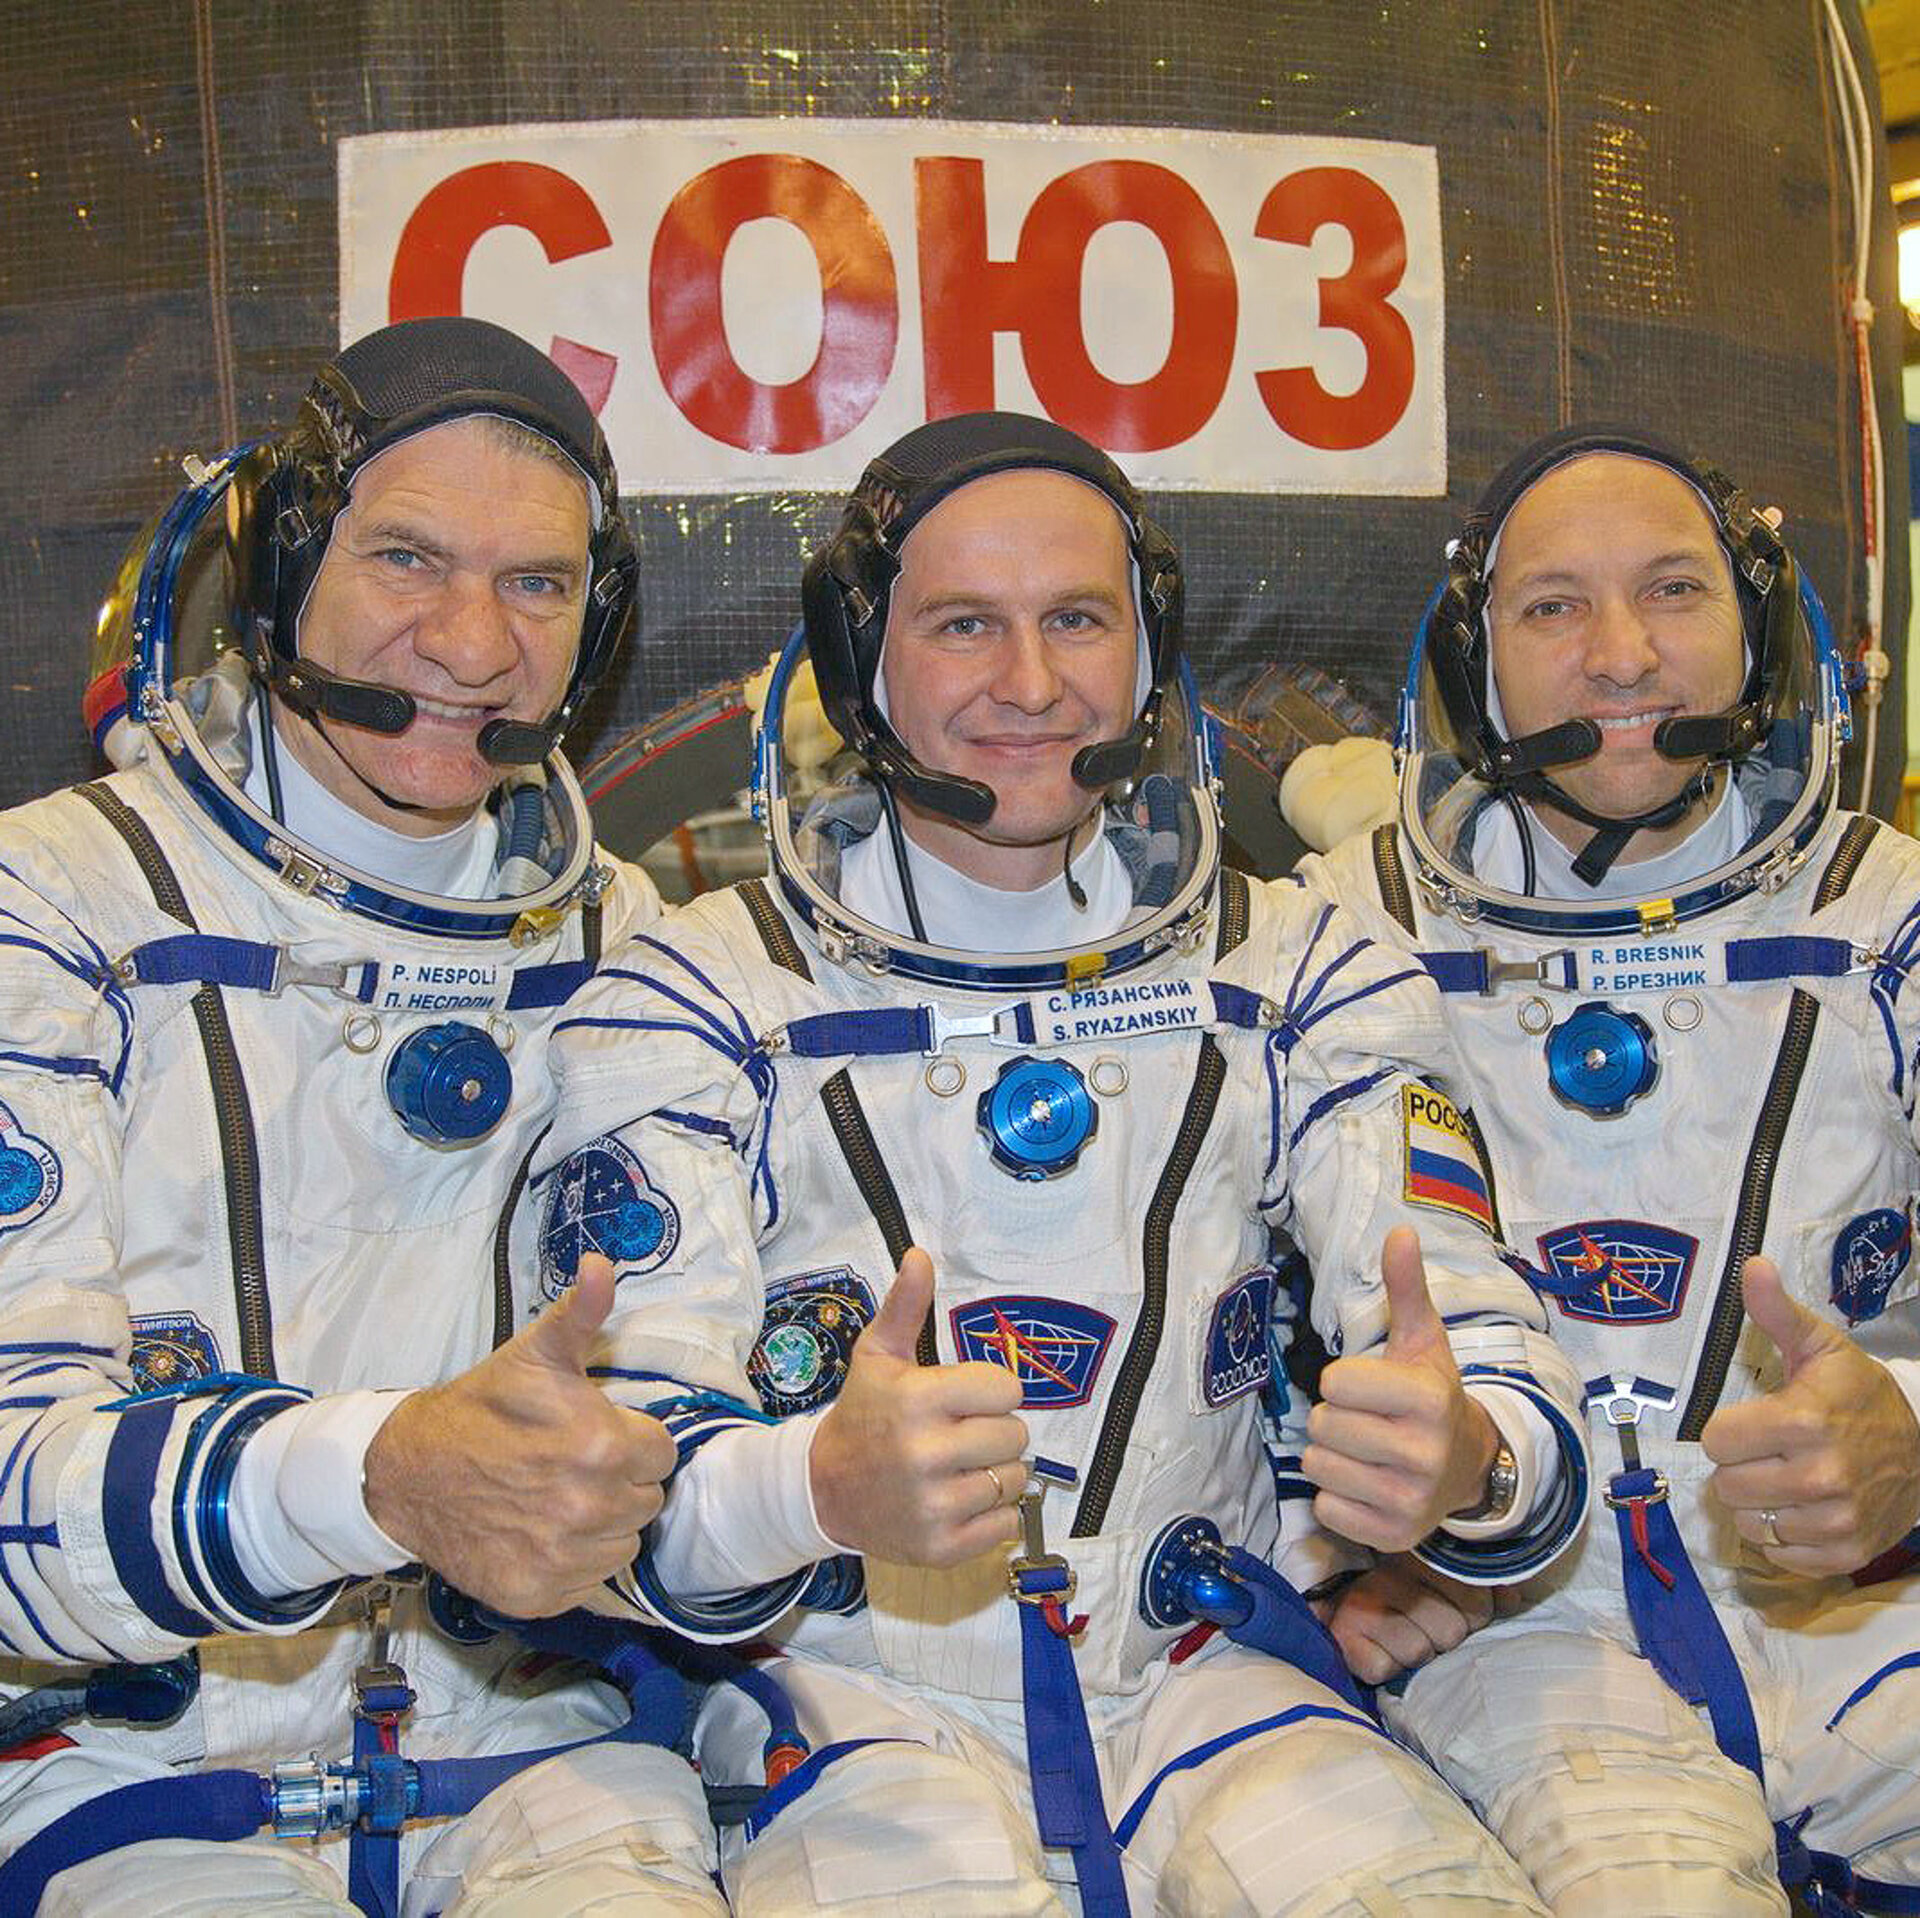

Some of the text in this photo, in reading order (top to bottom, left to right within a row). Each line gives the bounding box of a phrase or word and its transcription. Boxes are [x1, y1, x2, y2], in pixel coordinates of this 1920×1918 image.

[388, 153, 1416, 455] СОЮЗ
[1592, 945, 1705, 964] R. BRESNIK
[392, 965, 409, 981] P.
[1592, 970, 1706, 990] Р. БРЕЗНИК
[384, 992, 495, 1010] П. НЕСПОЛИ
[1048, 979, 1192, 1012] С. РЯЗАНСКИЙ
[1053, 1006, 1197, 1041] S. RYAZANSKIY
